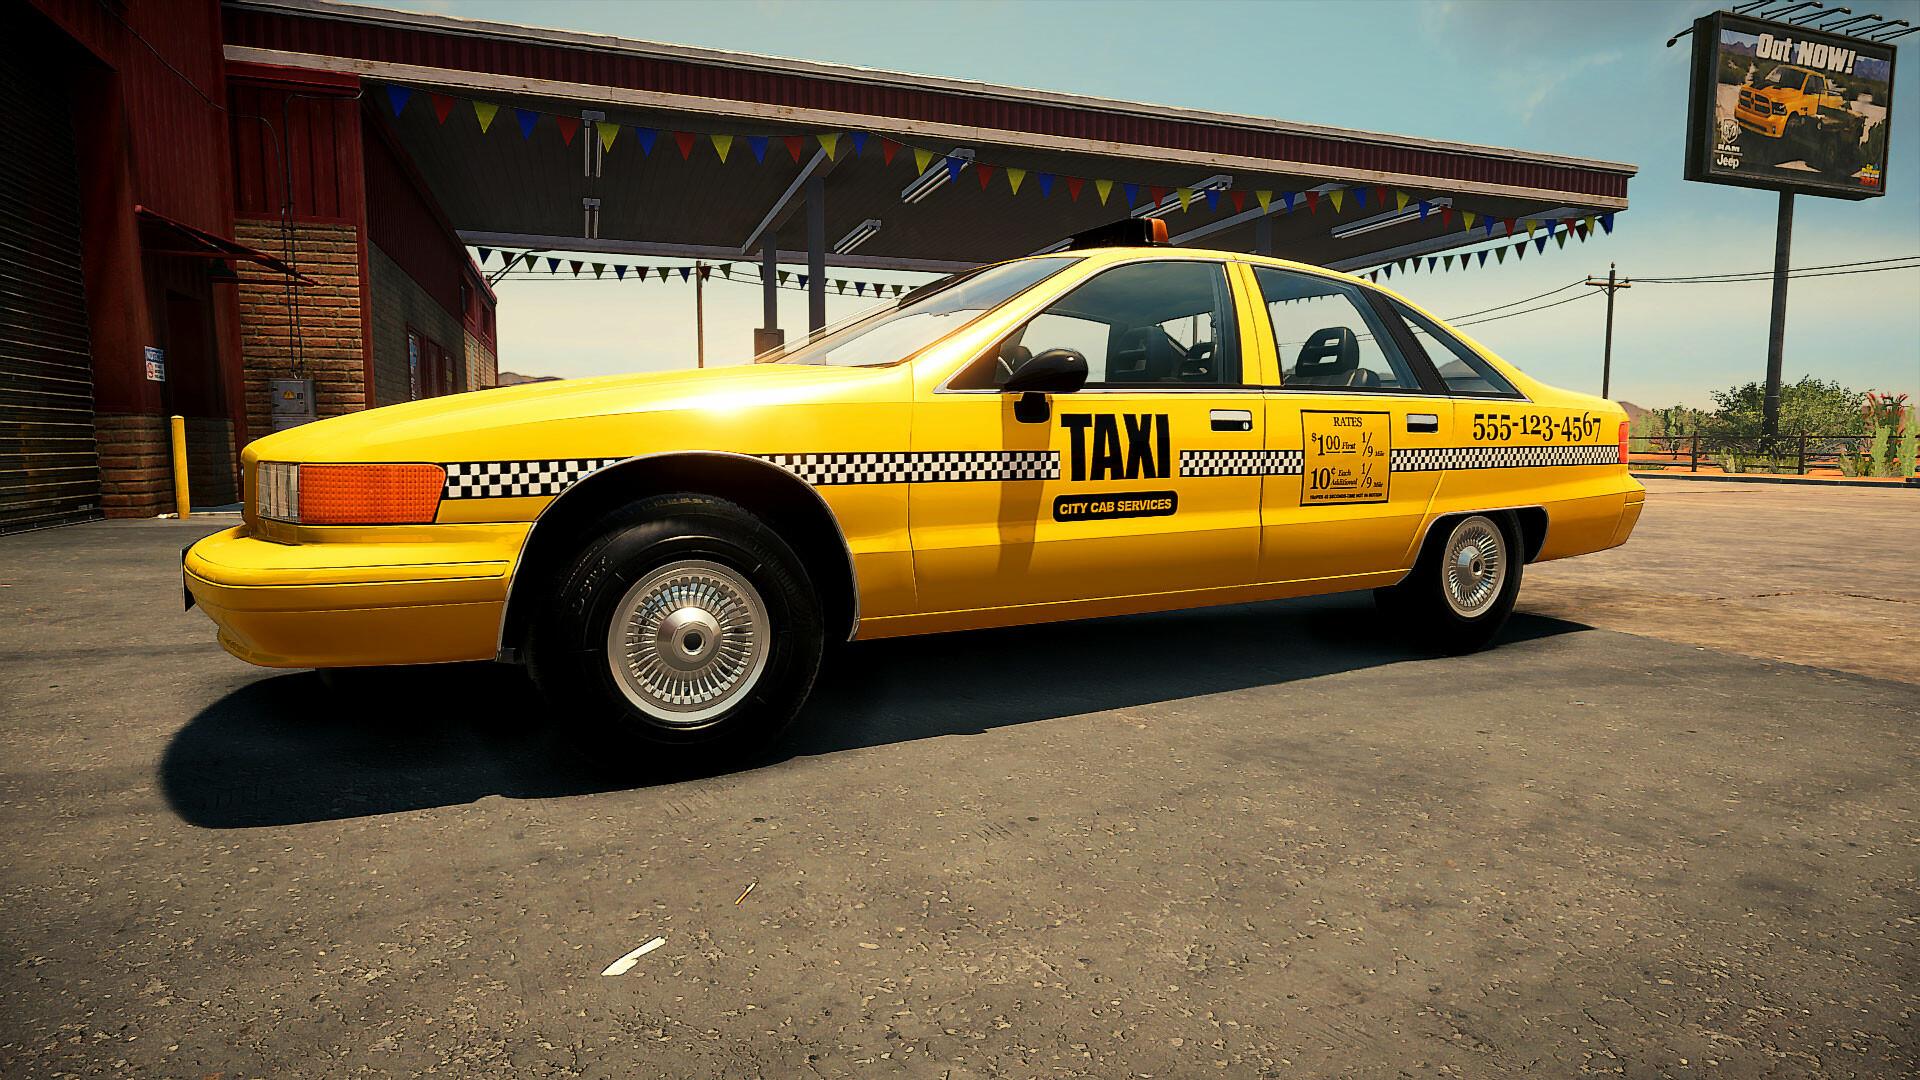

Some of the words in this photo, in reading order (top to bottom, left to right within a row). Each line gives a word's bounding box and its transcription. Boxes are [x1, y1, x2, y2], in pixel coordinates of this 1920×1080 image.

[1755, 33, 1793, 62] Out
[1796, 40, 1856, 74] NOW!
[1716, 154, 1740, 169] Jeep
[1333, 416, 1363, 427] RATES
[1472, 411, 1602, 442] 555-123-4567
[1060, 413, 1171, 482] TAXI
[1059, 502, 1088, 515] CITY
[1090, 501, 1115, 513] CAB
[1117, 498, 1172, 512] SERVICES
